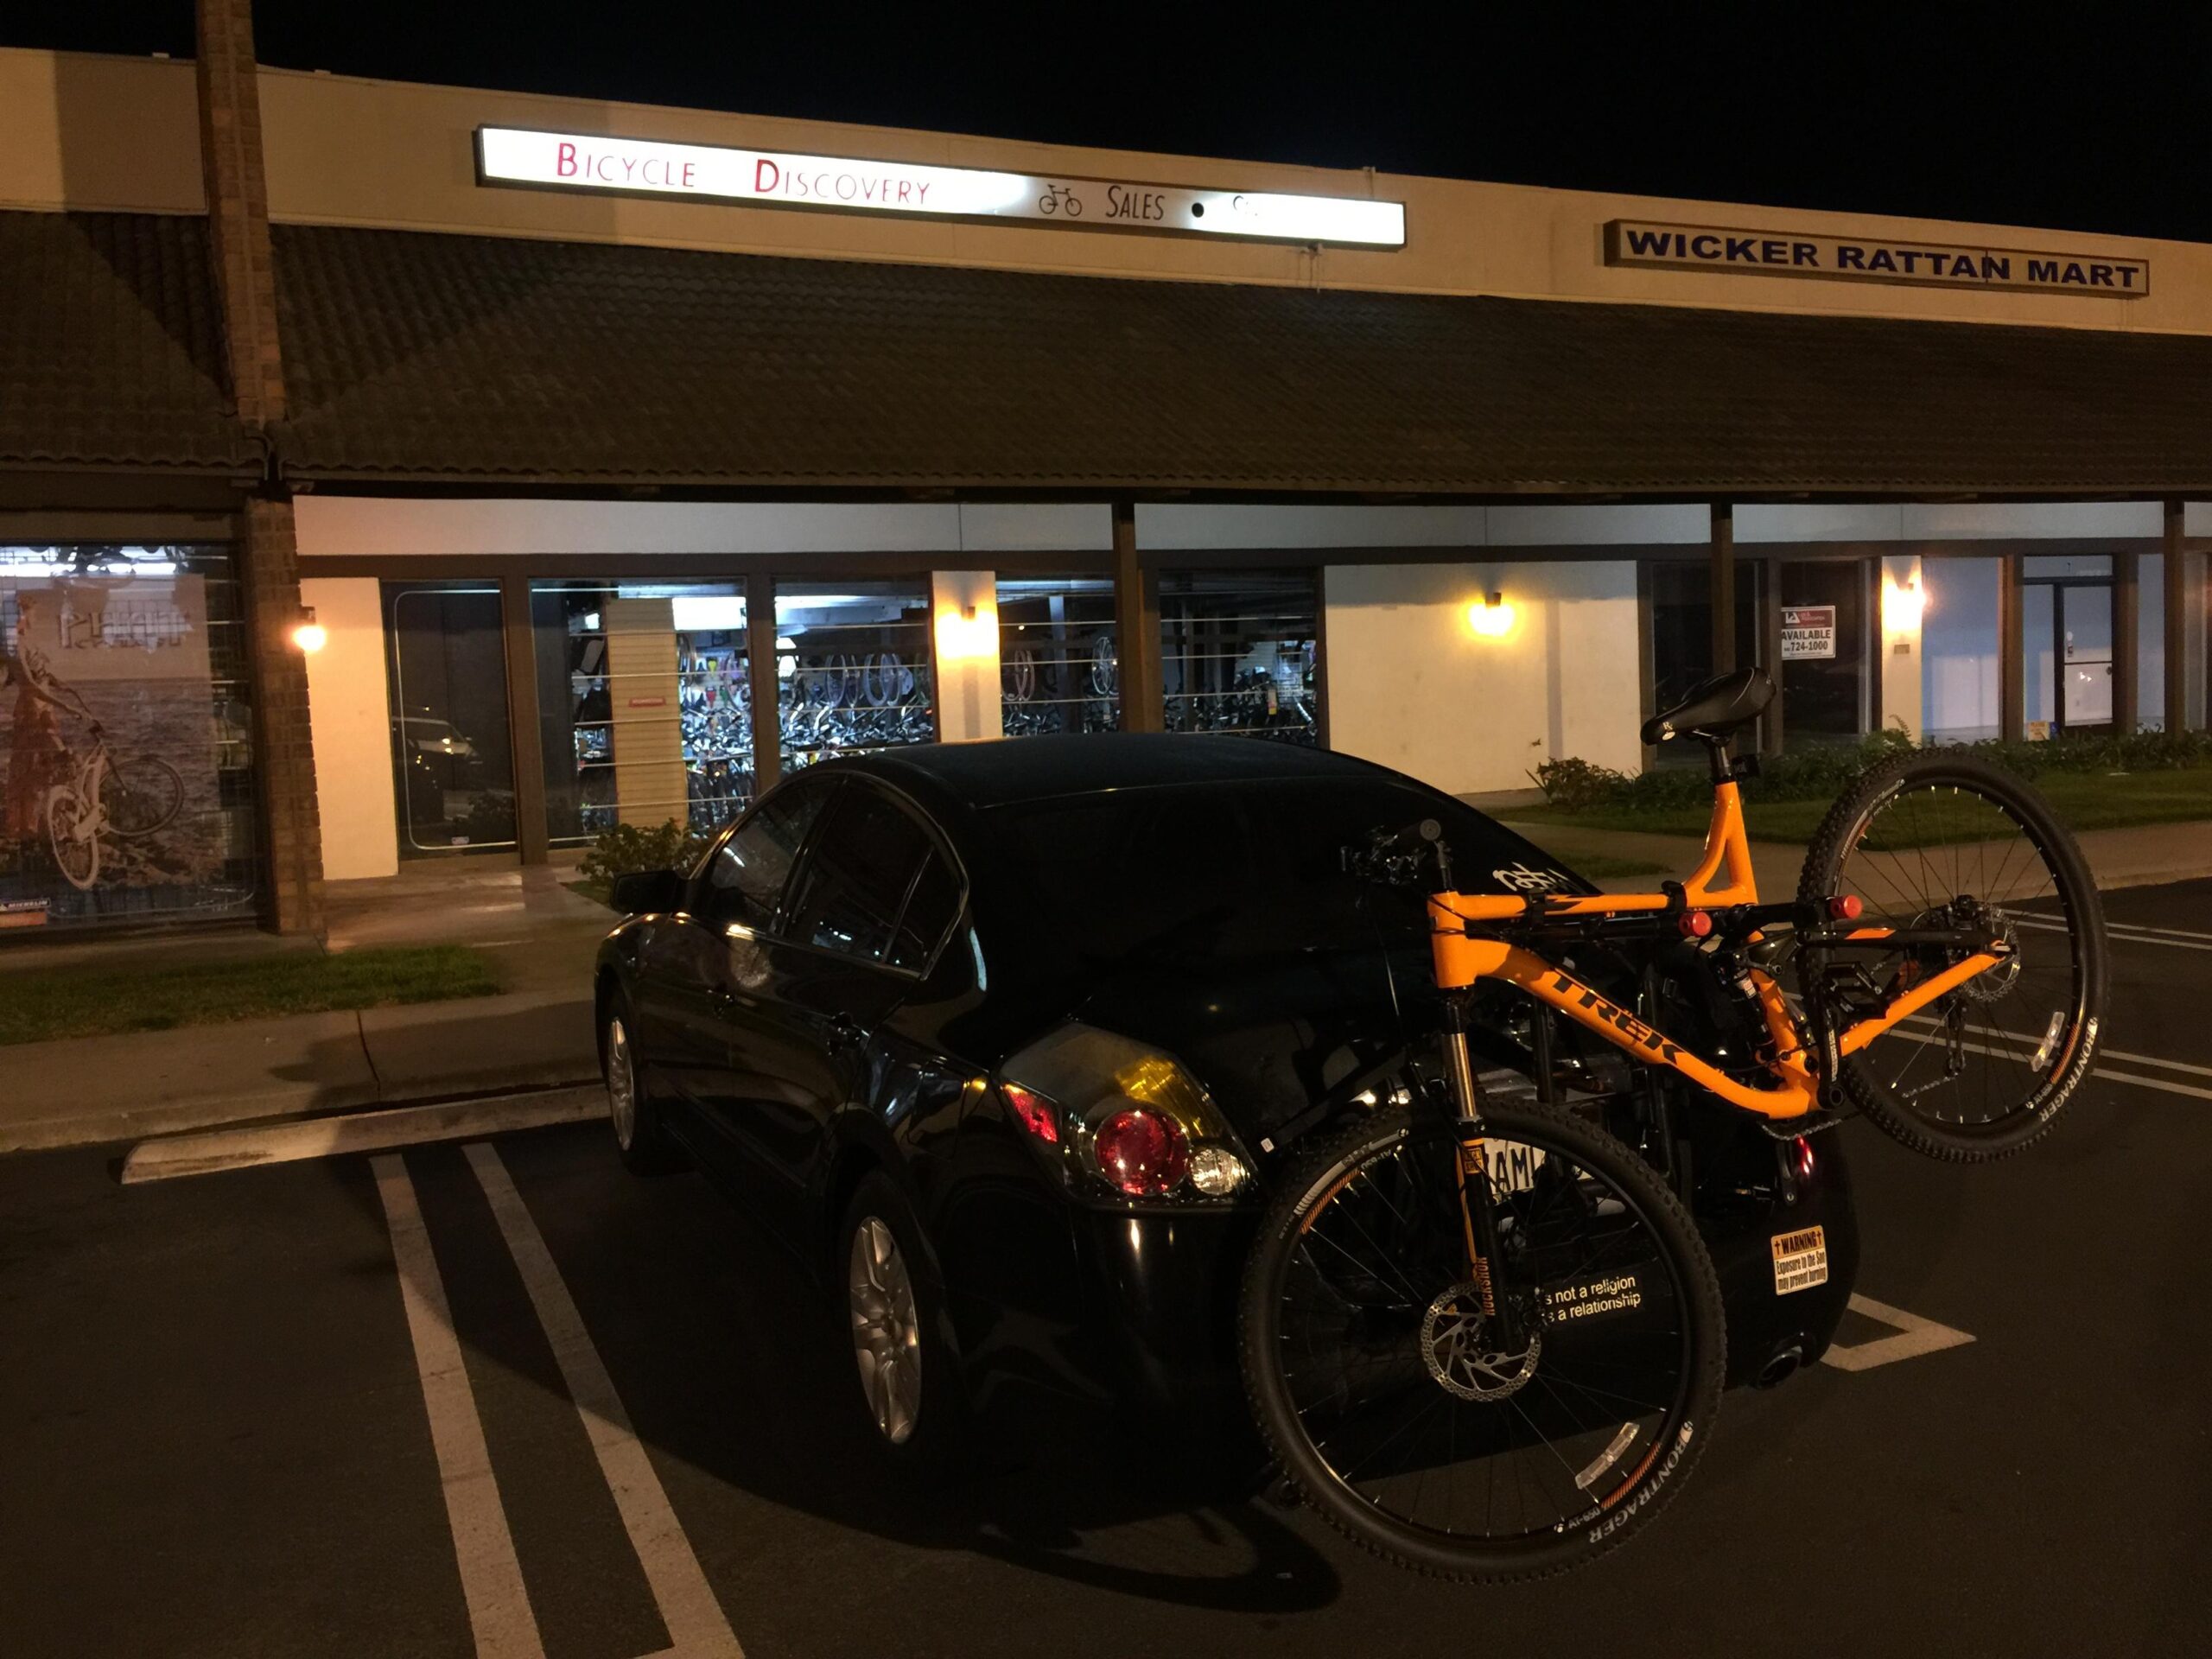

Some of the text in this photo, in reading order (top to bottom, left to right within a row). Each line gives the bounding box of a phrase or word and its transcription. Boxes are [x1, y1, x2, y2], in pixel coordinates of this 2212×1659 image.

[1626, 230, 2139, 288] WICKER RATTAN MART
[1781, 630, 1831, 640] AVAILABLE
[1552, 976, 1685, 1065] TREK
[2039, 1033, 2094, 1122] BONTRAGER
[1781, 1231, 1817, 1255] WARNING
[1555, 1287, 1576, 1303] not
[1579, 1287, 1588, 1298] a
[1591, 1275, 1636, 1295] religion
[1558, 1309, 1567, 1321] a
[1569, 1291, 1642, 1319] relationship
[1589, 1439, 1686, 1544] BONTRAGER
